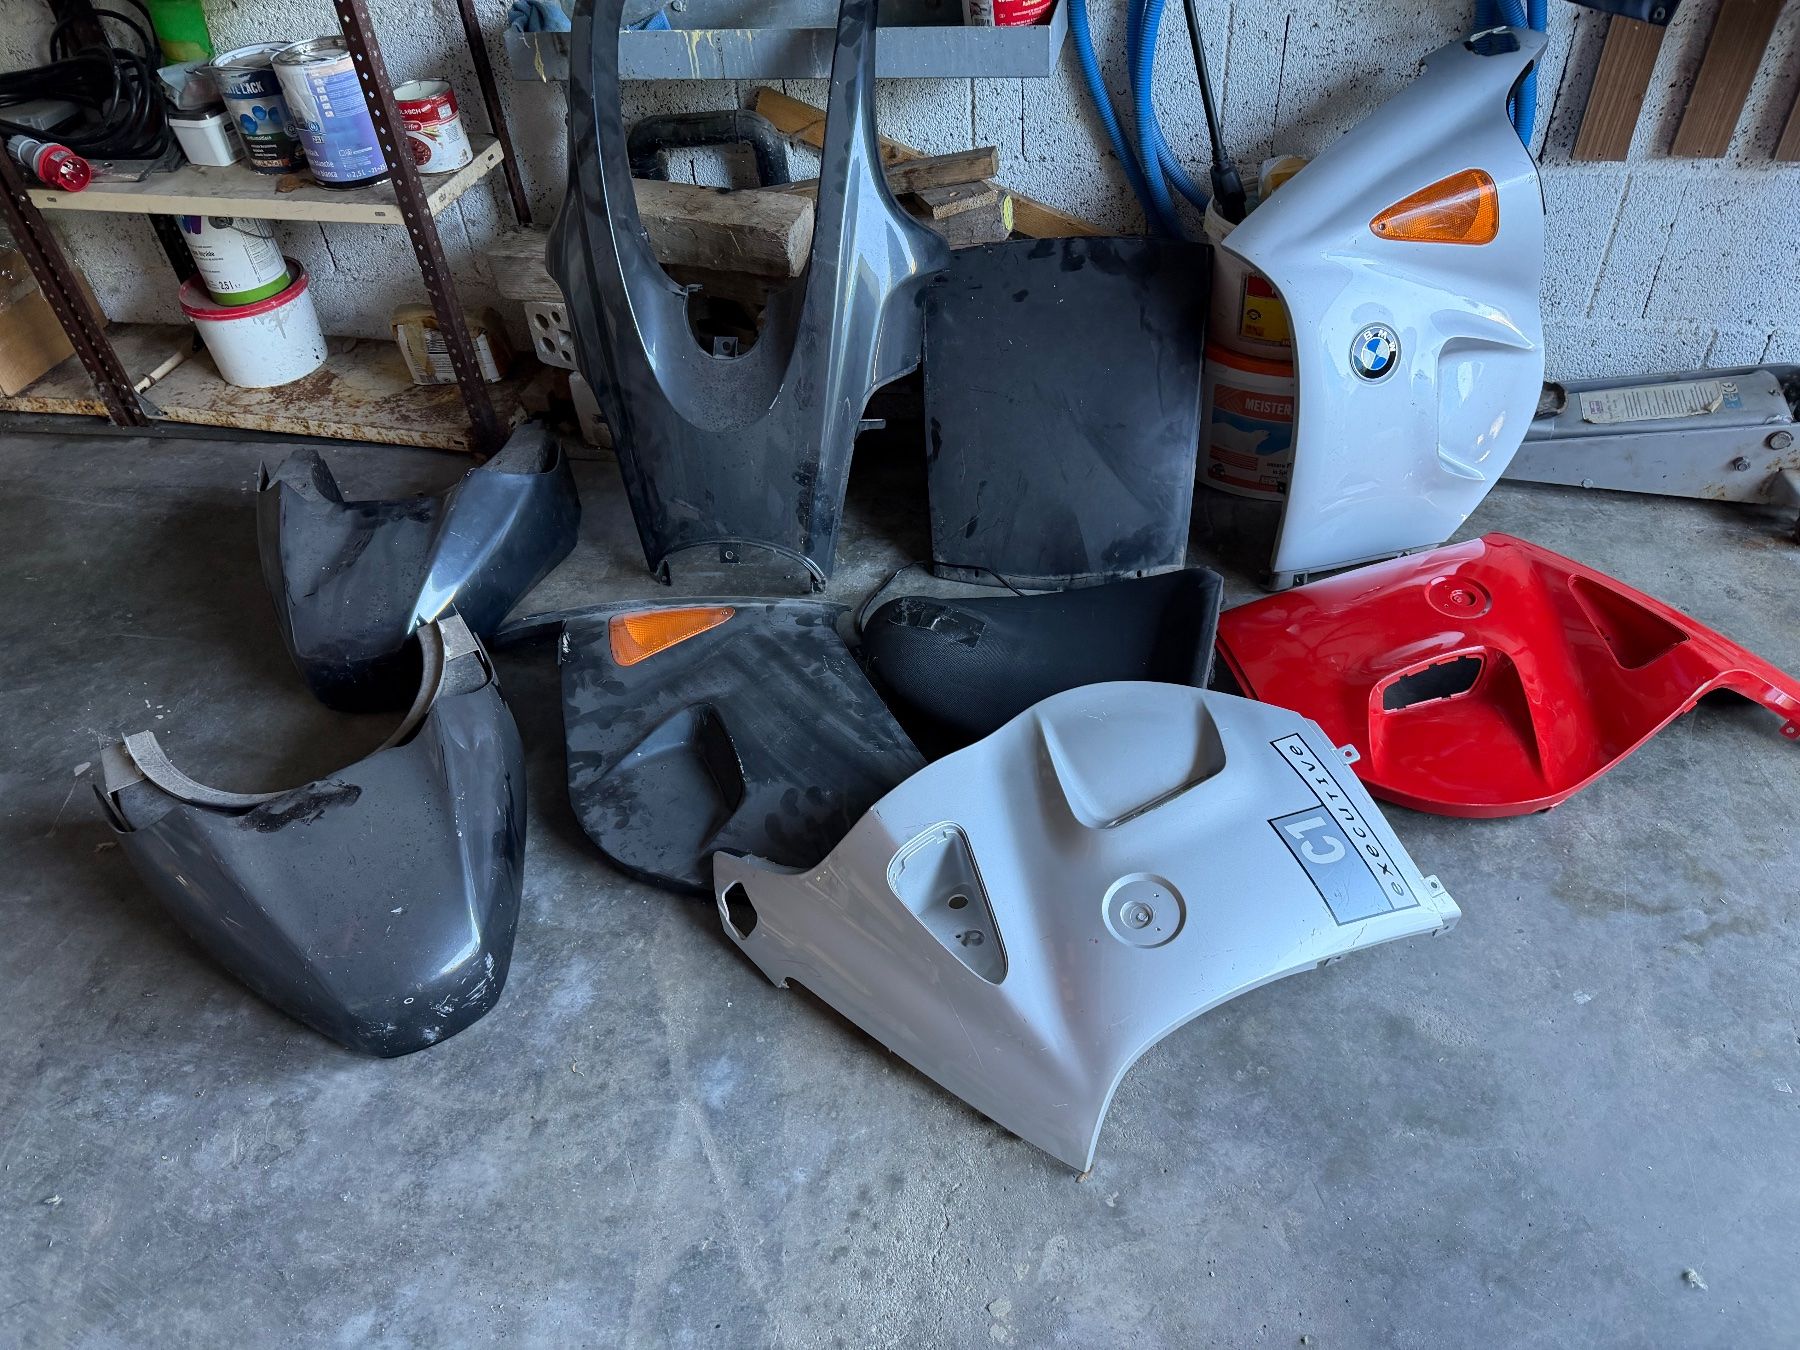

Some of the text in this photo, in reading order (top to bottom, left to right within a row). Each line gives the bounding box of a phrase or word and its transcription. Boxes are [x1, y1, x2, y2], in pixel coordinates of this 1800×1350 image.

[240, 81, 264, 94] LACK
[1363, 329, 1396, 352] BMW
[1245, 397, 1292, 416] MEISTER
[1284, 815, 1347, 865] C1
